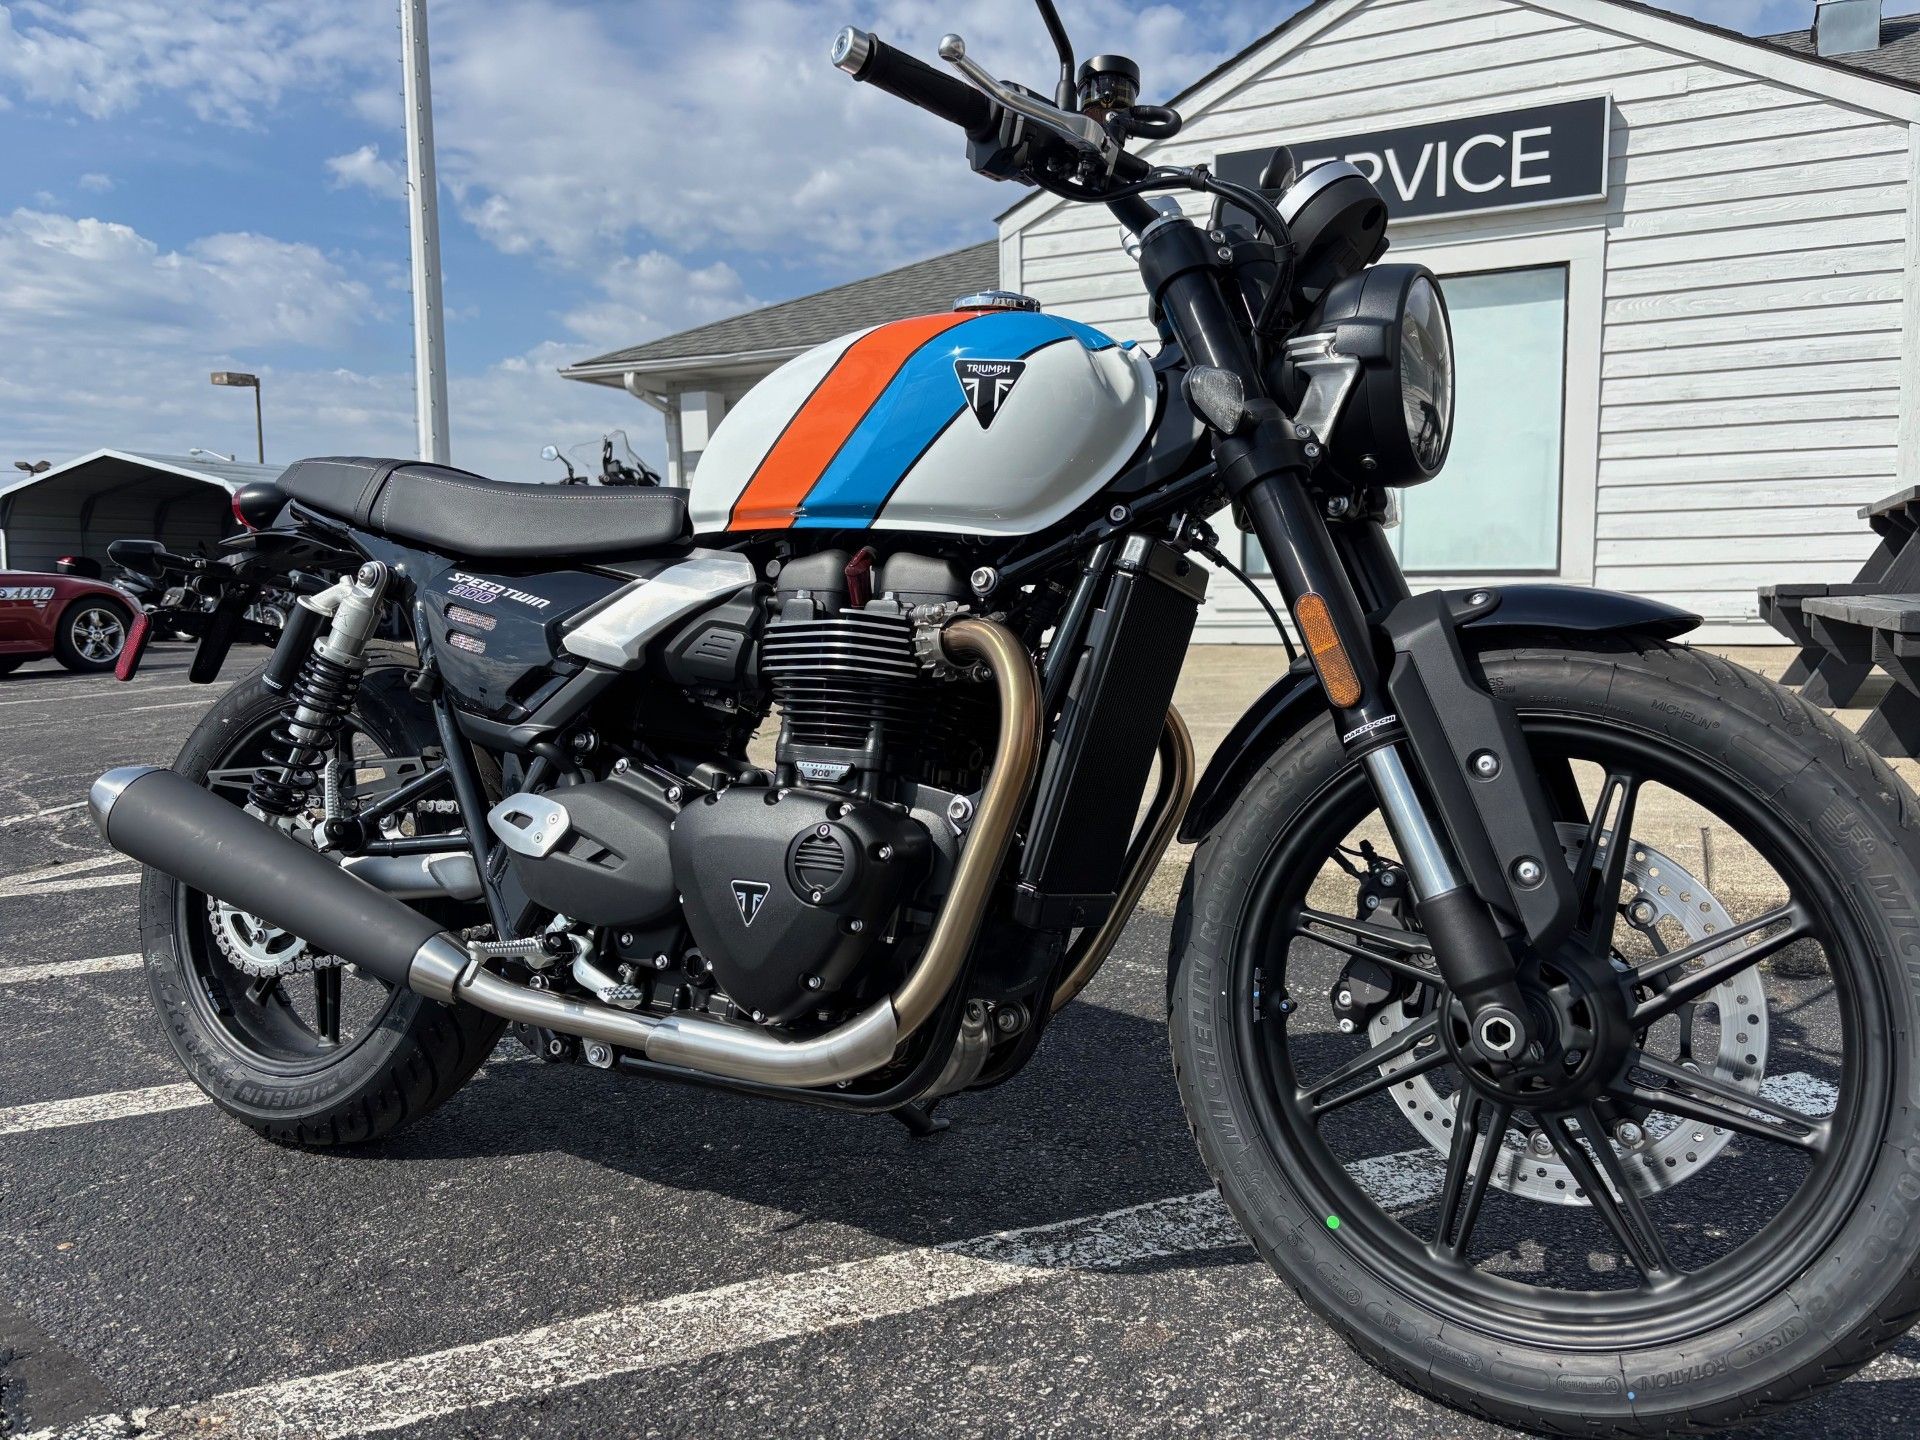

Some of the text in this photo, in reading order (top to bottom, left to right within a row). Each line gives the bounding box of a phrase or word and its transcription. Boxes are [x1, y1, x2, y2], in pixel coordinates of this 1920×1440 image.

[1259, 126, 1552, 202] RVICE
[966, 364, 1011, 374] TRIUMPH
[447, 572, 551, 609] SPEED TWIN
[447, 584, 498, 604] 900
[1343, 714, 1396, 743] MARZOCCHI
[812, 768, 831, 778] 900
[1640, 1357, 1728, 1392] ROTATION
